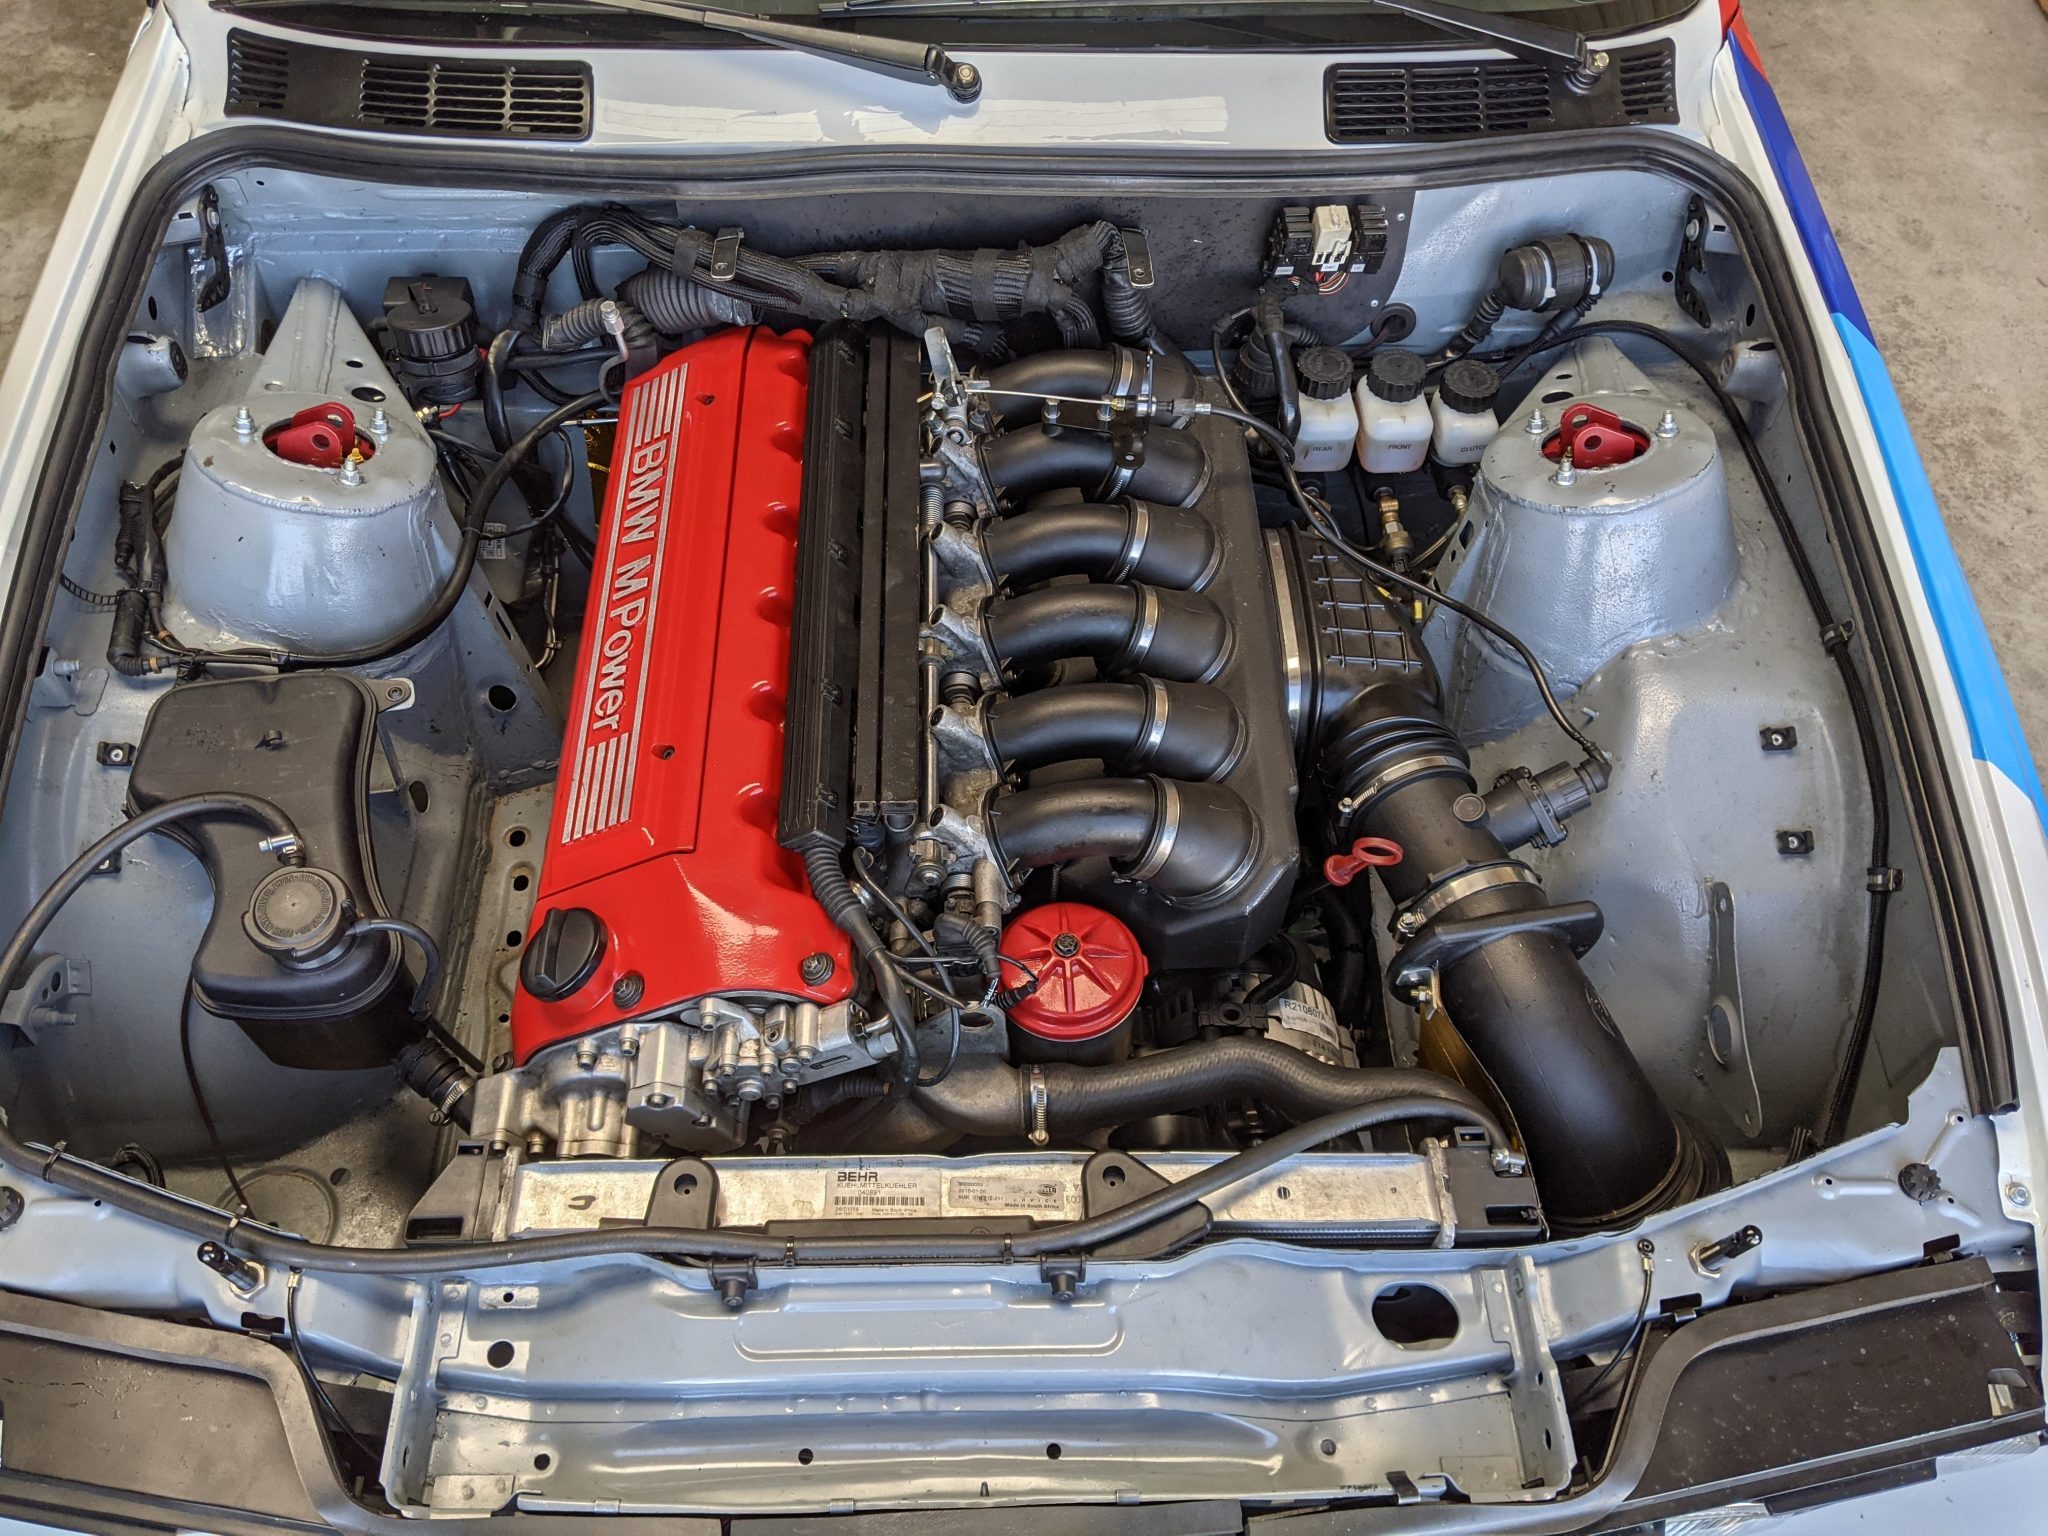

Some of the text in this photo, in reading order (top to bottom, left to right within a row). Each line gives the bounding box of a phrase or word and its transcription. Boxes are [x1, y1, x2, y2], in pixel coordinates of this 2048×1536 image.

[593, 446, 668, 733] BMW MPower
[837, 1171, 878, 1182] BEHR
